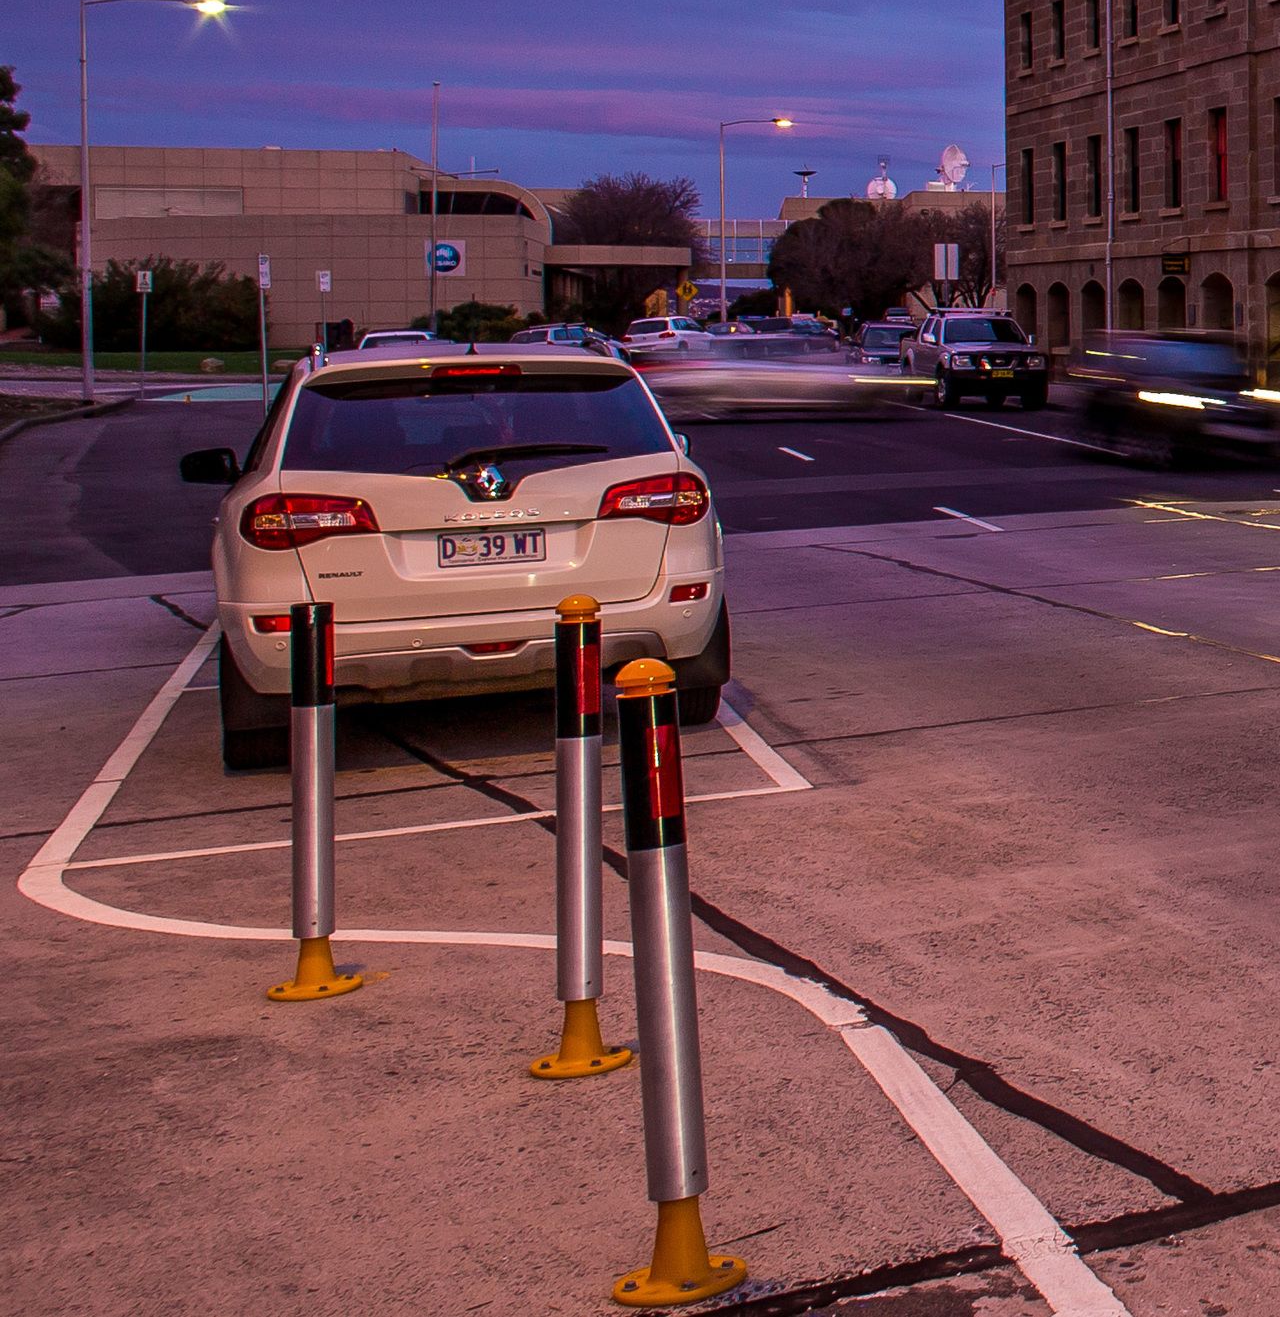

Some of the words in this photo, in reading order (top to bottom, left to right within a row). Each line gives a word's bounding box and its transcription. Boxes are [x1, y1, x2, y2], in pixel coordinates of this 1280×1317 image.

[444, 508, 541, 523] KOLEOS
[442, 538, 456, 559] D
[479, 535, 506, 557] 39
[512, 532, 541, 554] WT
[318, 571, 364, 579] RENAULT
